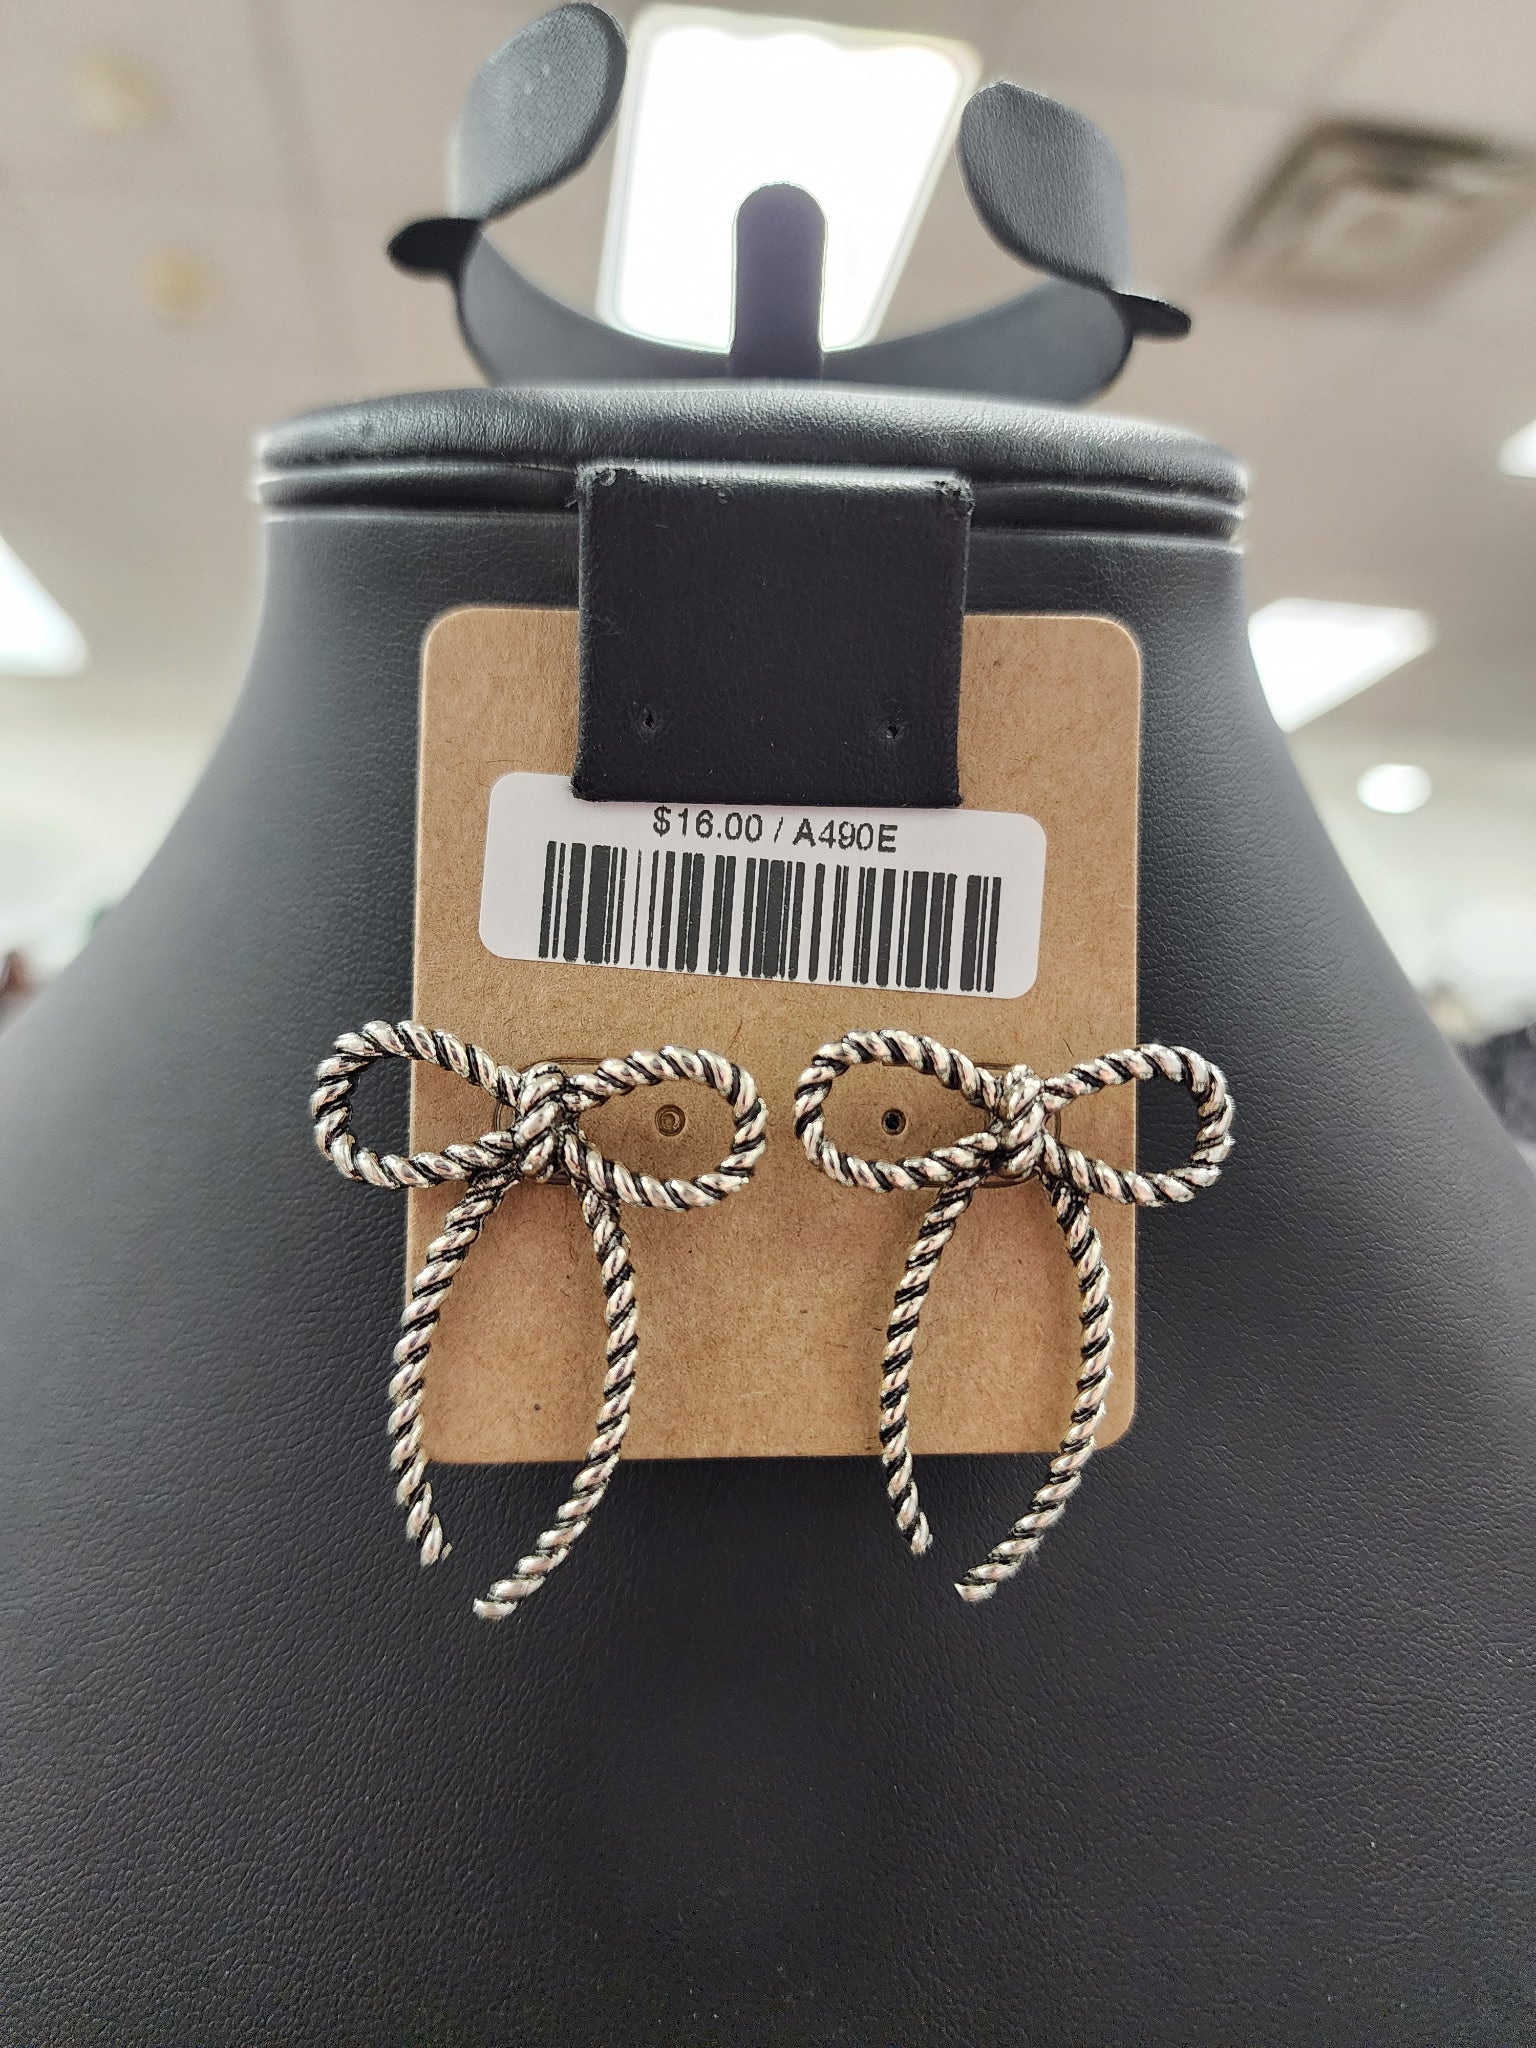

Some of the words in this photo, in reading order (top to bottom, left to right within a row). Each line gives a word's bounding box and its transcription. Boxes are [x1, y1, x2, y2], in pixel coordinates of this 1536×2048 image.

[652, 804, 763, 844] $16.00
[773, 816, 784, 843] /
[792, 817, 898, 854] A490E
